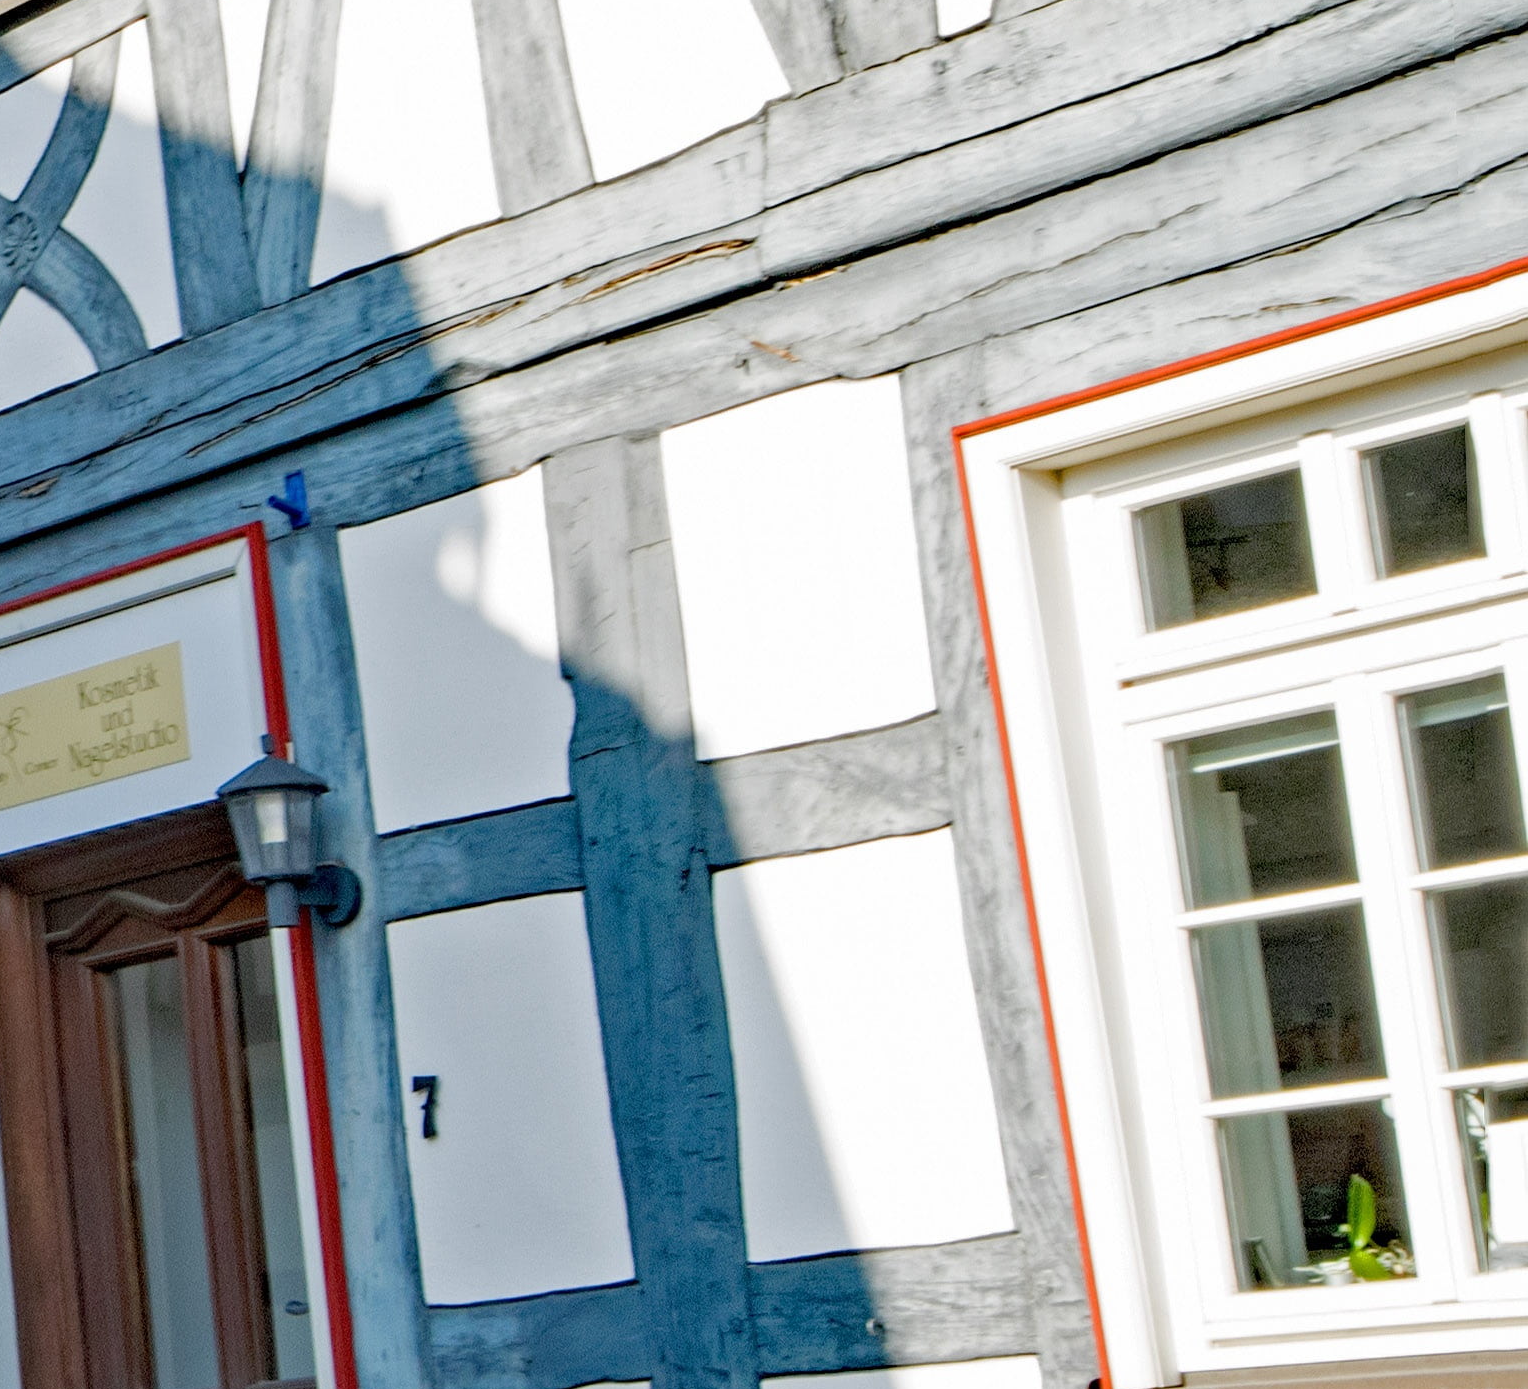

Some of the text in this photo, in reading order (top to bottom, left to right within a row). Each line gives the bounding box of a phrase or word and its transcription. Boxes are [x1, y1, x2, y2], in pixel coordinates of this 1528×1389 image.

[77, 662, 160, 710] Kosmetik
[100, 699, 134, 732] und
[67, 718, 181, 777] Nagelstudio
[411, 1075, 438, 1139] 7
